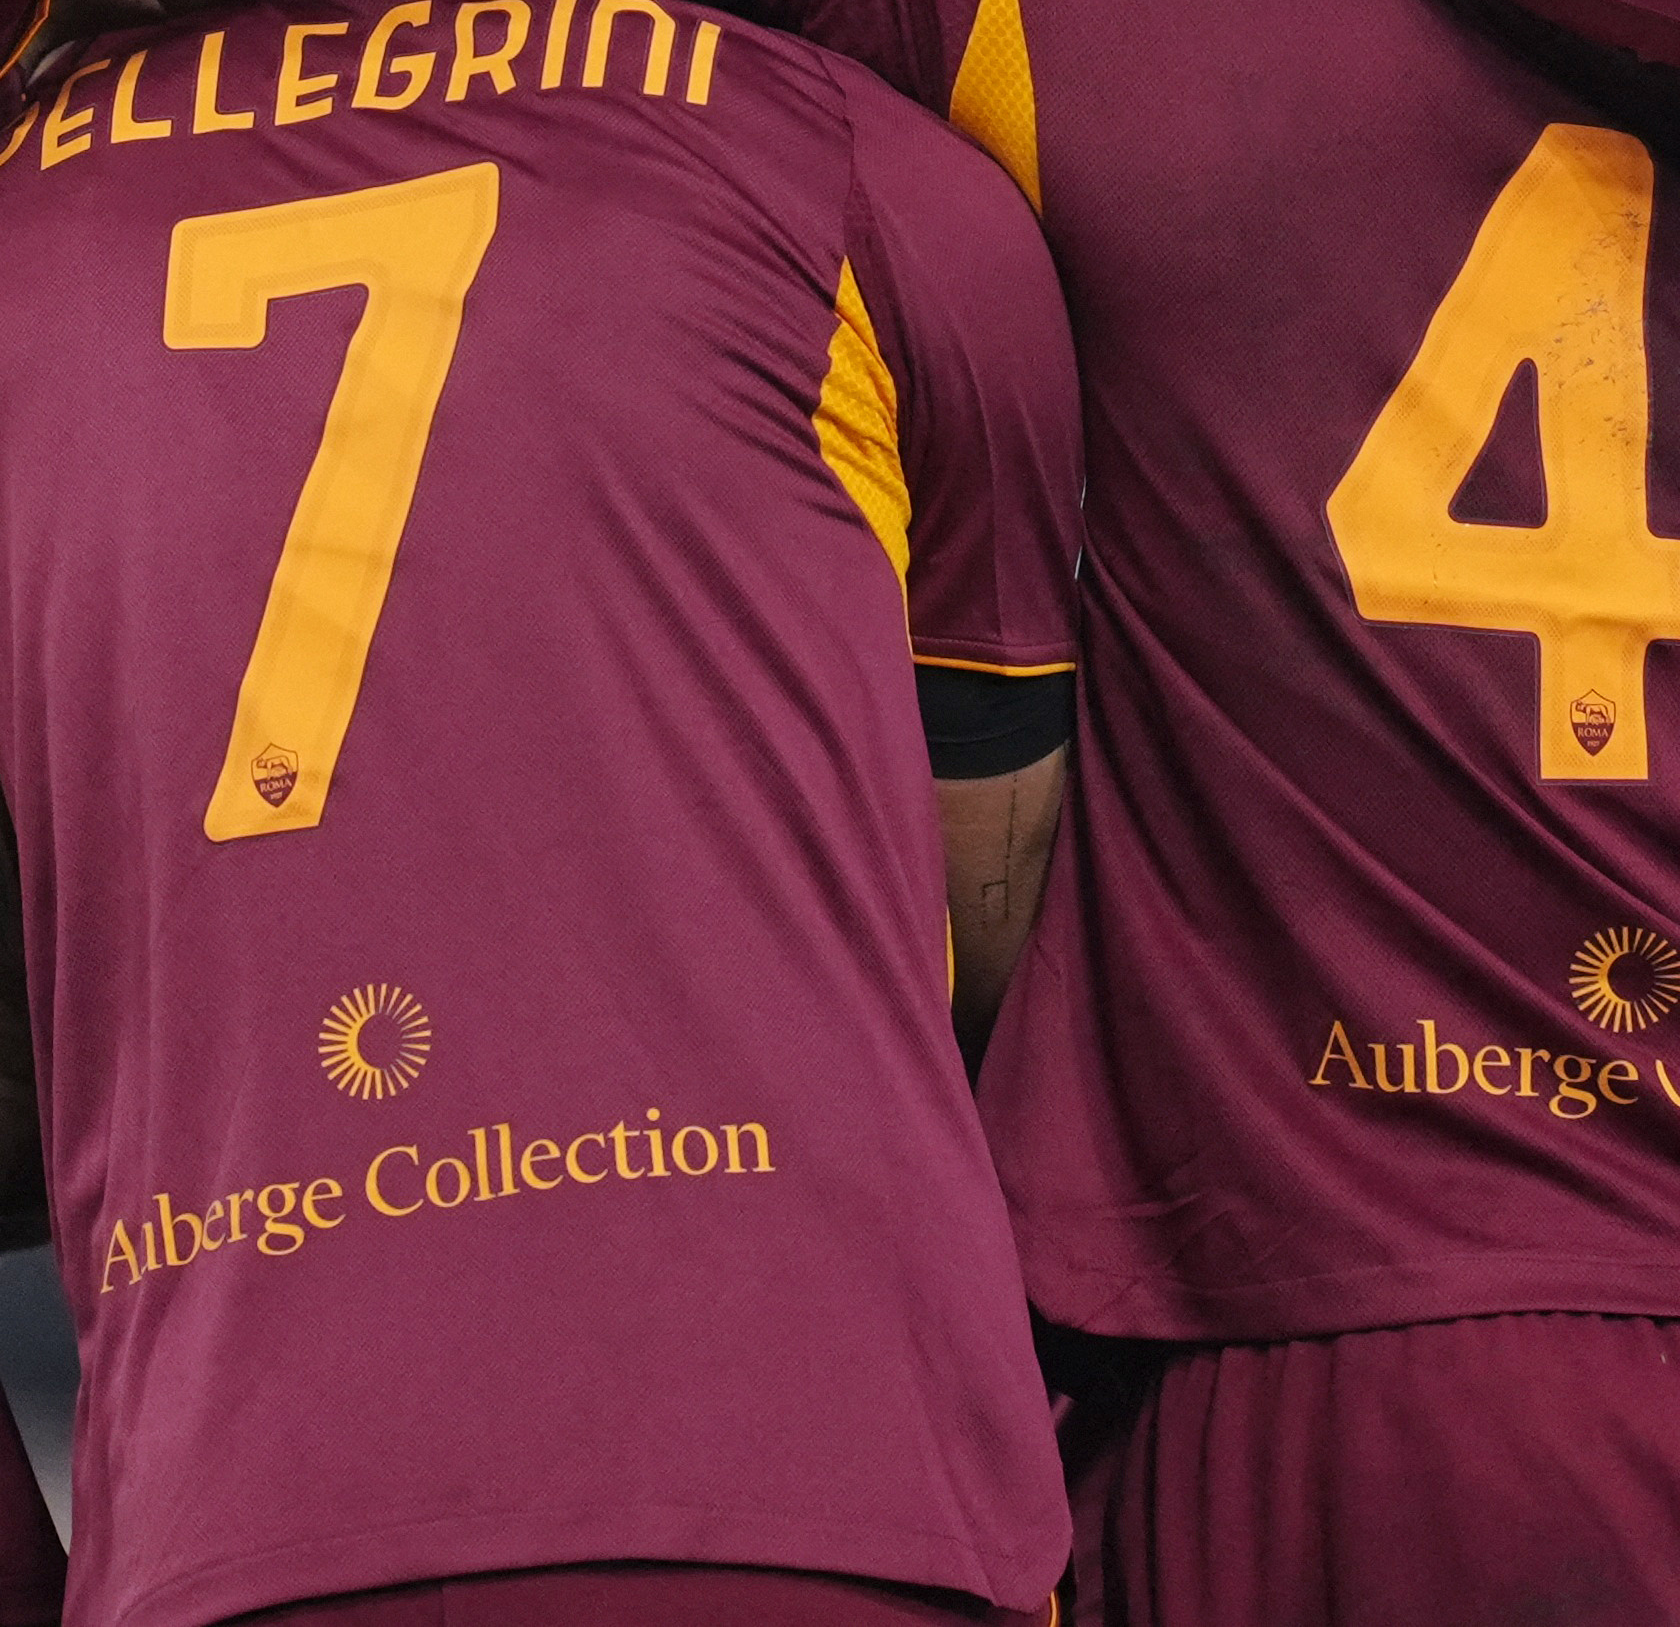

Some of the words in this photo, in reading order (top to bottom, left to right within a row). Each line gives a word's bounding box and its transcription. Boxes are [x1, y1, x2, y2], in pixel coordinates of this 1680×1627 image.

[163, 161, 500, 843] 7
[1577, 726, 1609, 738] ROMA
[1308, 1019, 1640, 1120] Auberge
[365, 1107, 776, 1218] Collection
